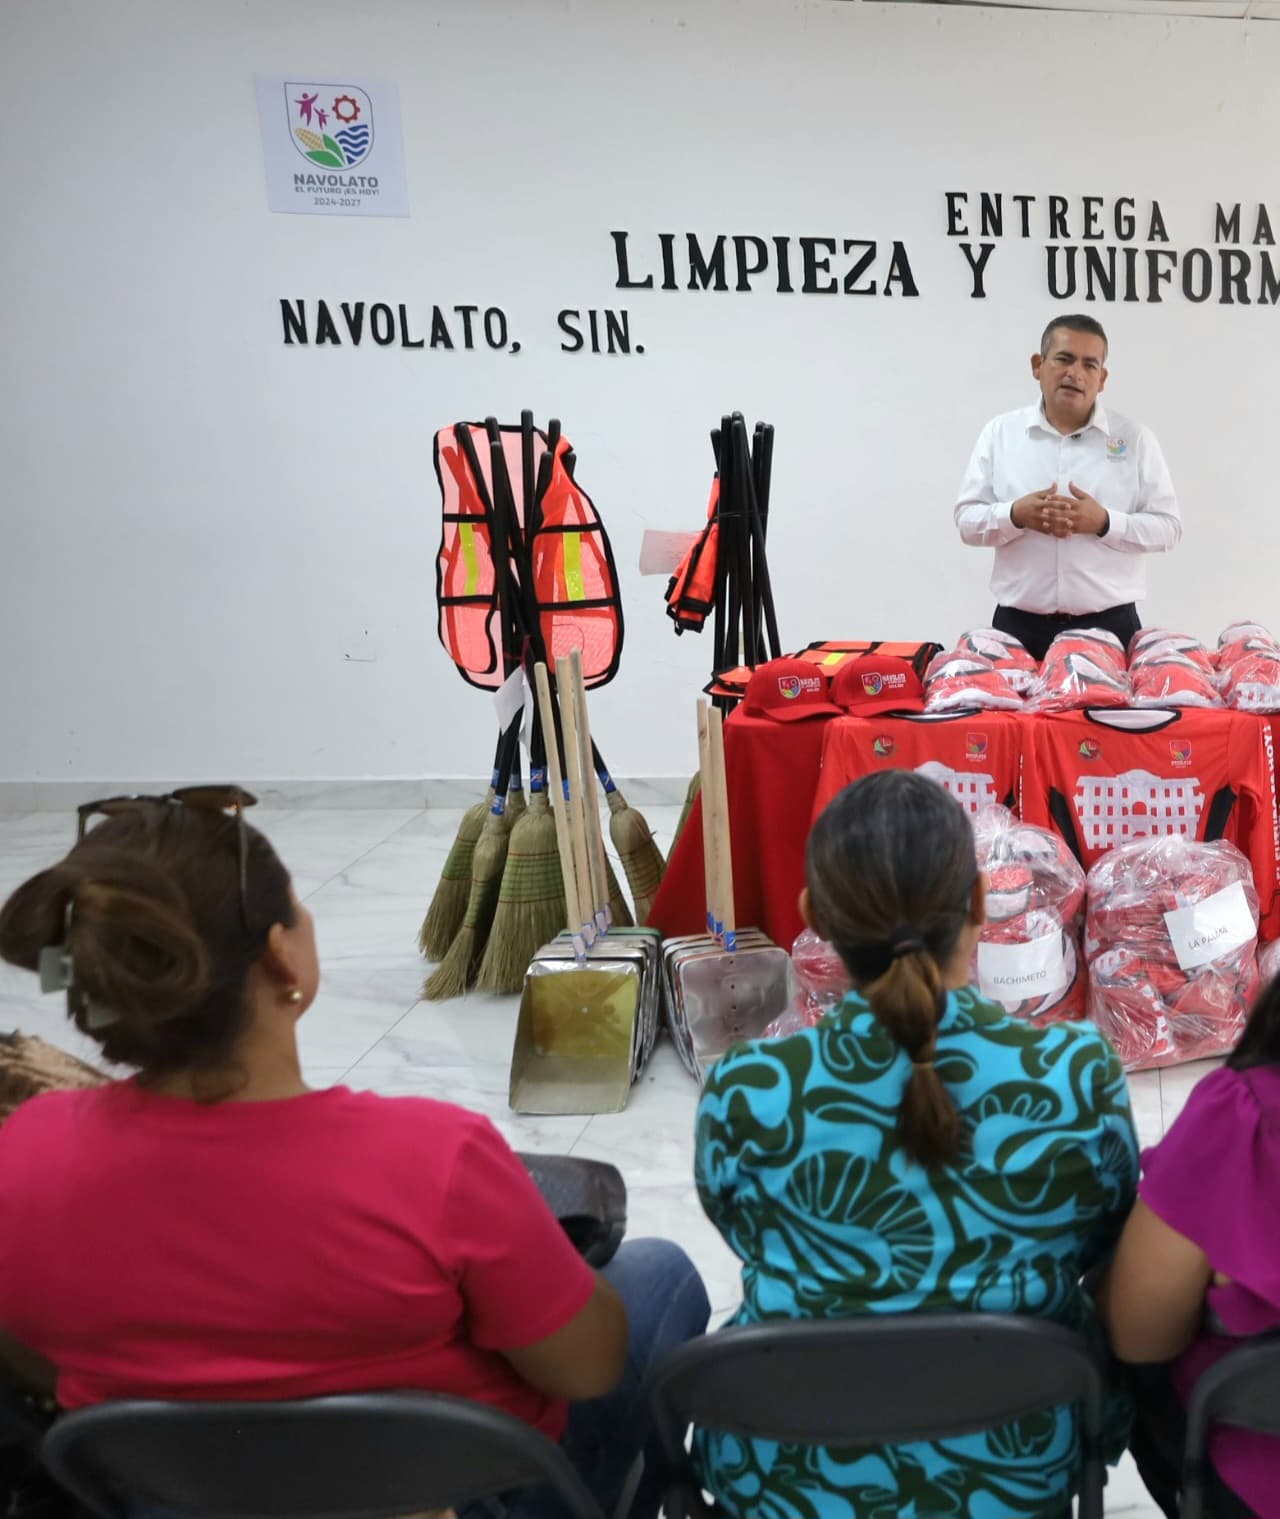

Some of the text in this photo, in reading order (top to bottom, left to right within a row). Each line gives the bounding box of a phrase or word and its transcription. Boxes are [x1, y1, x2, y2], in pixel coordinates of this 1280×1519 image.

[294, 173, 379, 188] NAVOLATO
[313, 197, 361, 207] 2024-2027
[944, 191, 1170, 242] ENTREGA
[610, 231, 920, 297] LIMPIEZA
[958, 243, 996, 299] Y
[279, 298, 645, 354] NAVOLATO, SIN.
[993, 970, 1047, 985] BACHIMETO
